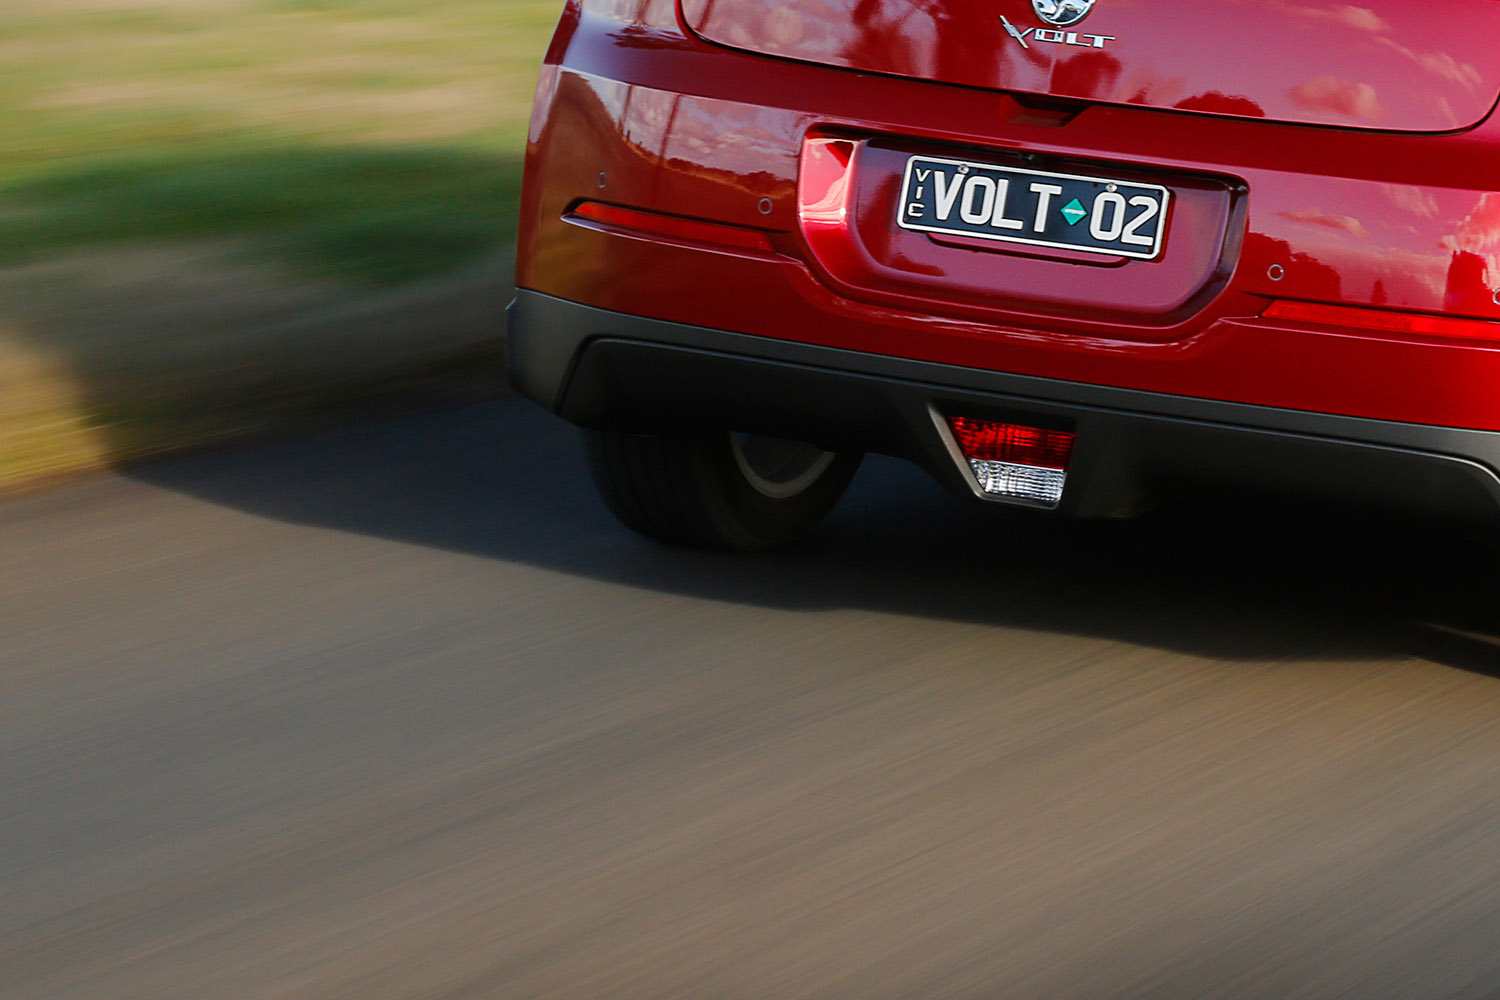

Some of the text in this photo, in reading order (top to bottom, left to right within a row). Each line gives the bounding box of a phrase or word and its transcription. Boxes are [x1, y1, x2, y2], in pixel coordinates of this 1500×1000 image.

[999, 14, 1116, 48] VOLT
[907, 168, 931, 217] VIC
[933, 170, 1159, 246] VOLT 02
